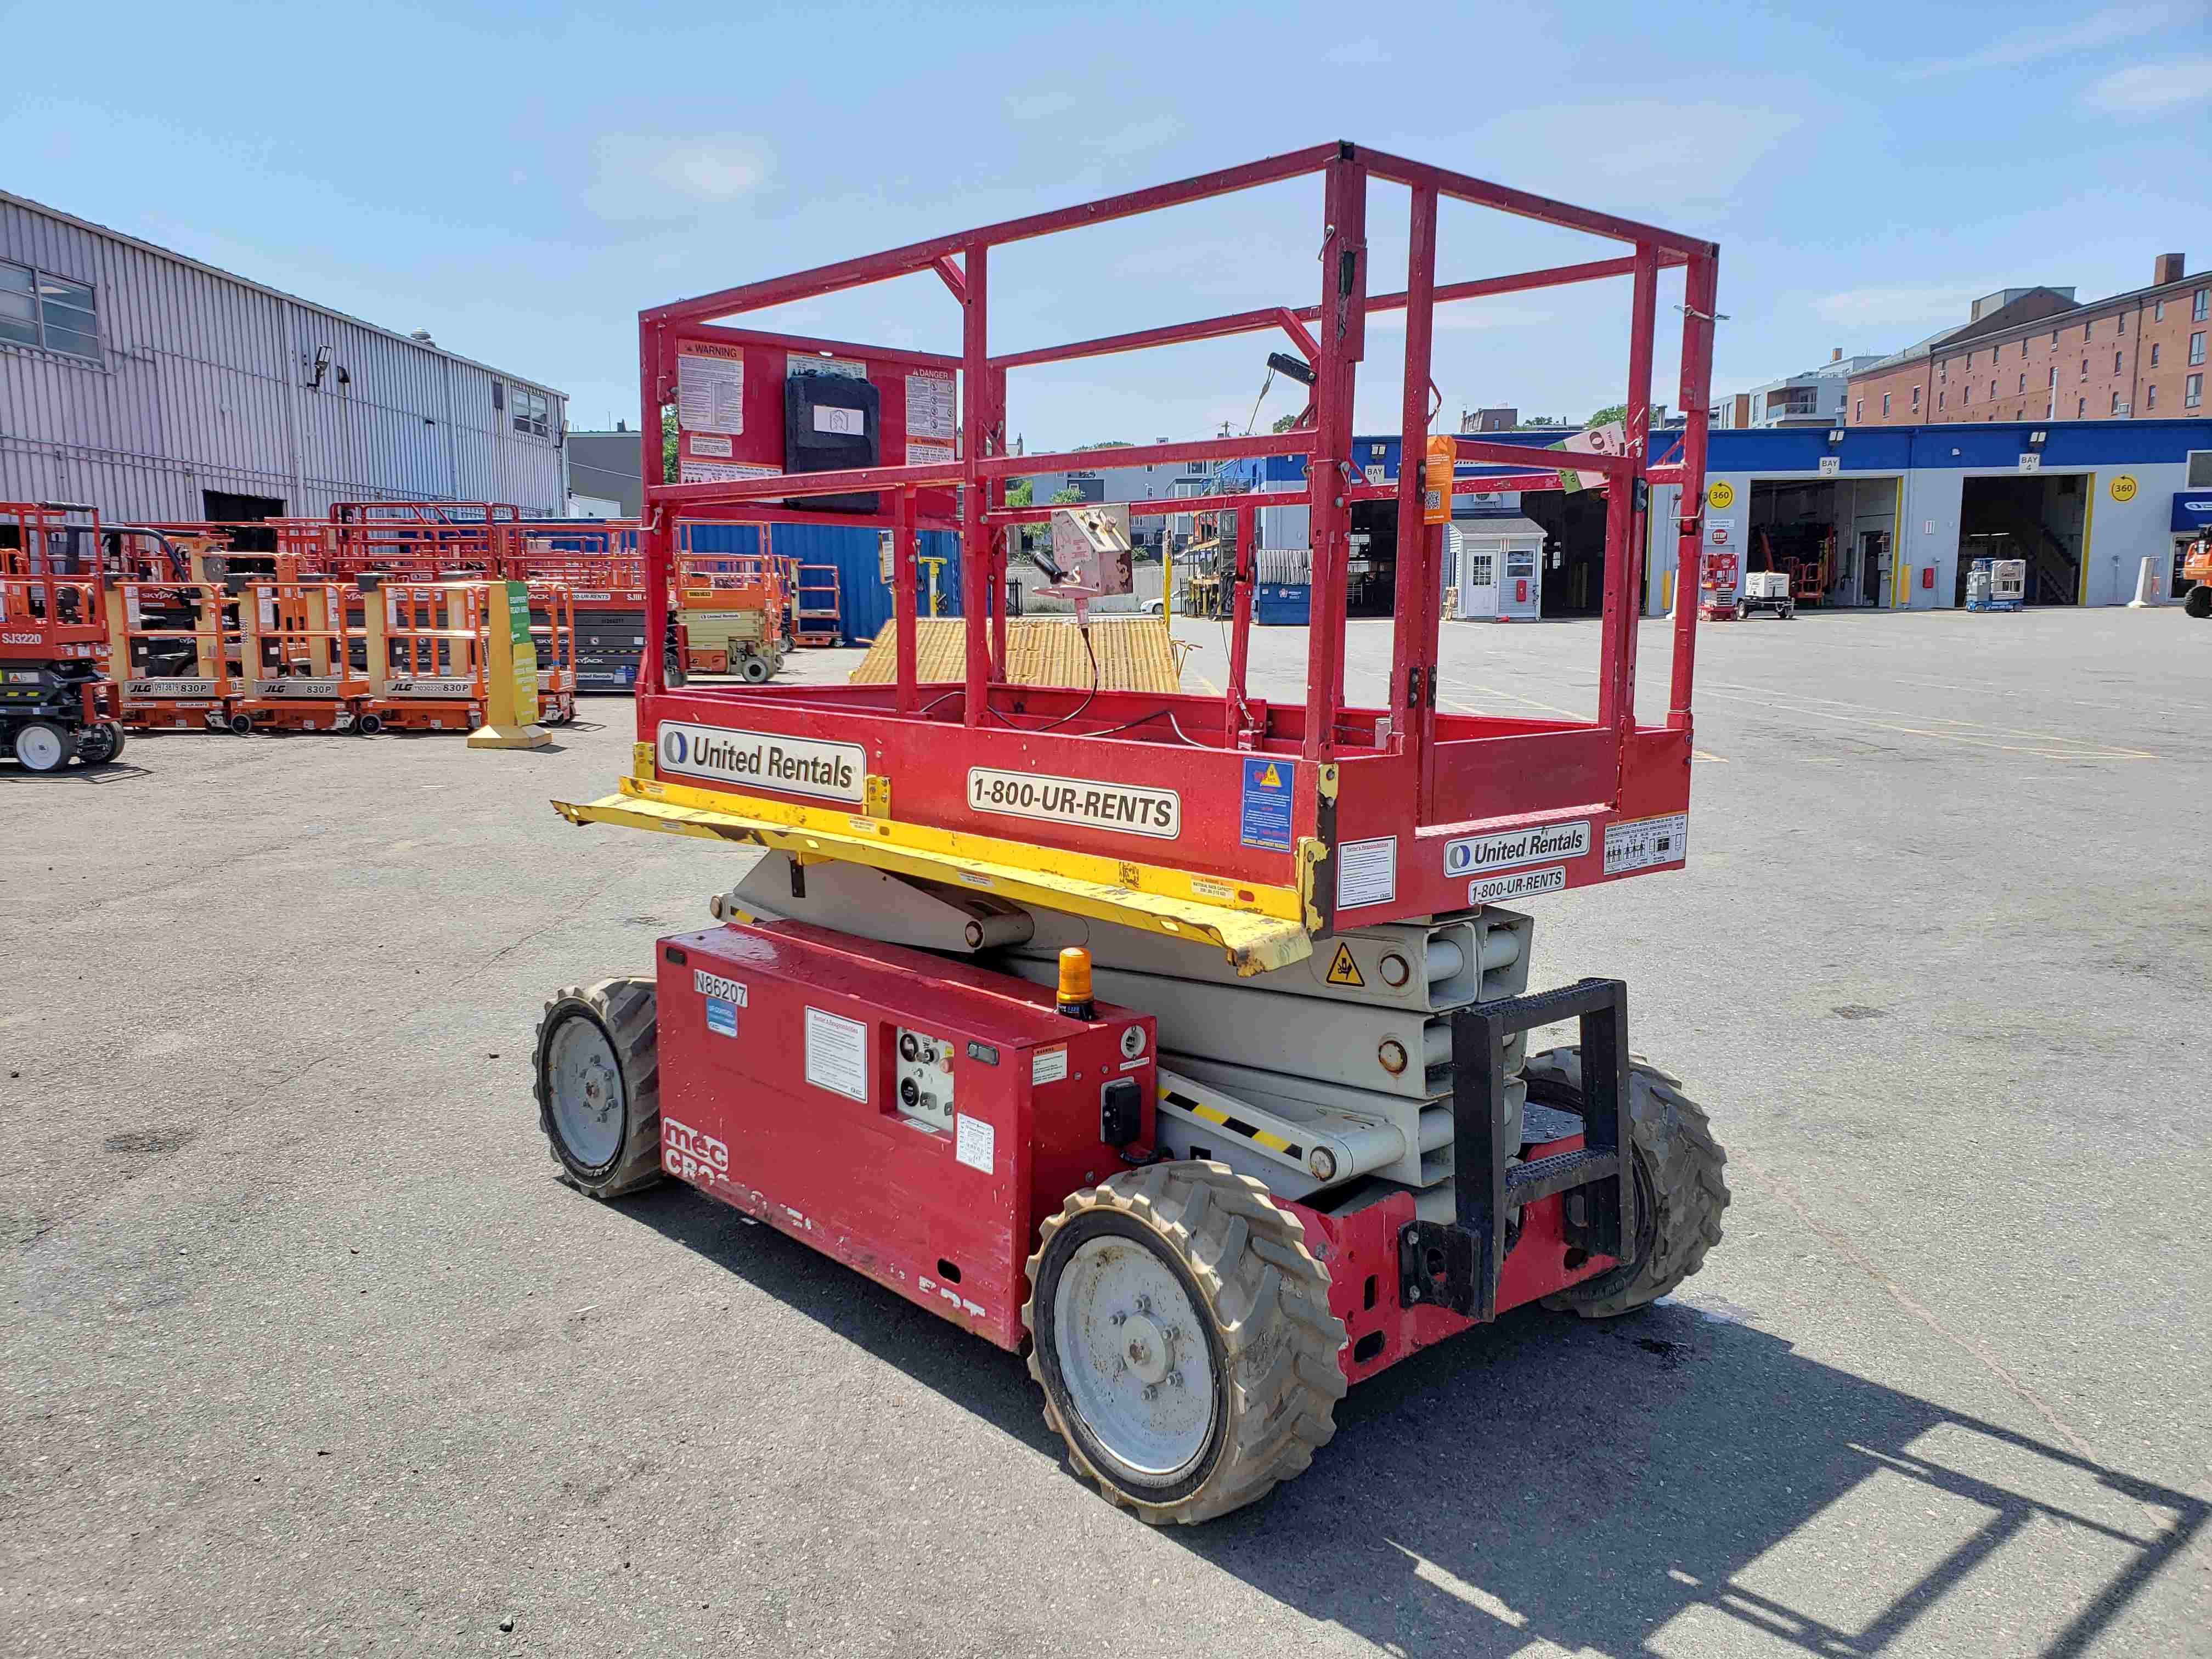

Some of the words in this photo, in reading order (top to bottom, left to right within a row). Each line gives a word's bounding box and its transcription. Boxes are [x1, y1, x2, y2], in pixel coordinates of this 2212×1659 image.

[695, 345, 737, 358] WARNING
[919, 369, 948, 380] DANGER
[2, 633, 42, 644] SJ3220
[265, 685, 285, 693] JLG
[694, 736, 763, 775] United
[768, 746, 853, 788] Rentals
[974, 778, 1172, 827] 1-800-UR-RENTS
[1474, 837, 1527, 865] United
[1529, 830, 1583, 855] Rentals
[1472, 871, 1561, 901] 1-800-UR-RENTS
[696, 971, 746, 1005] N86207
